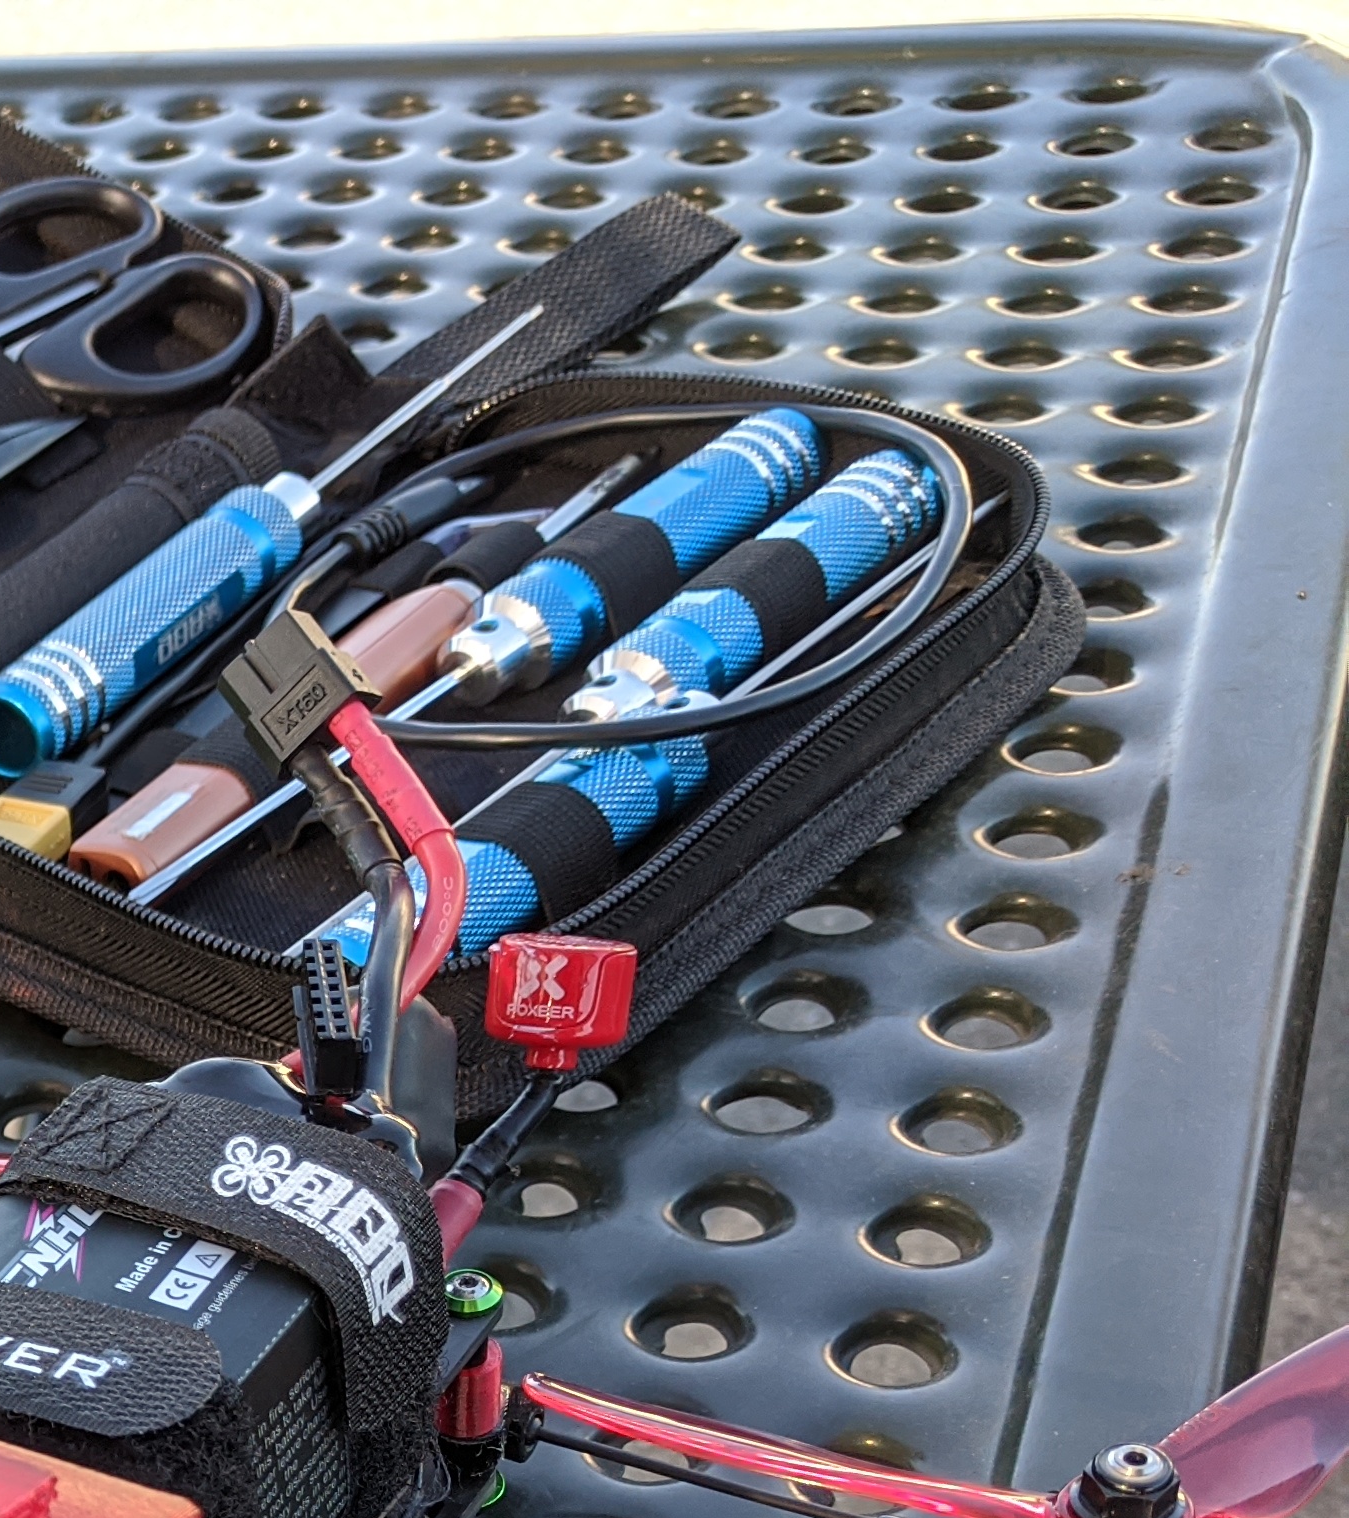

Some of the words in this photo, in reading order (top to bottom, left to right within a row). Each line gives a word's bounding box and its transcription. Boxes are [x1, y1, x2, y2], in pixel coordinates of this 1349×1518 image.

[277, 682, 328, 736] XT60
[114, 1256, 159, 1293] Made
[149, 1240, 172, 1259] in
[207, 1270, 250, 1313] guidelines
